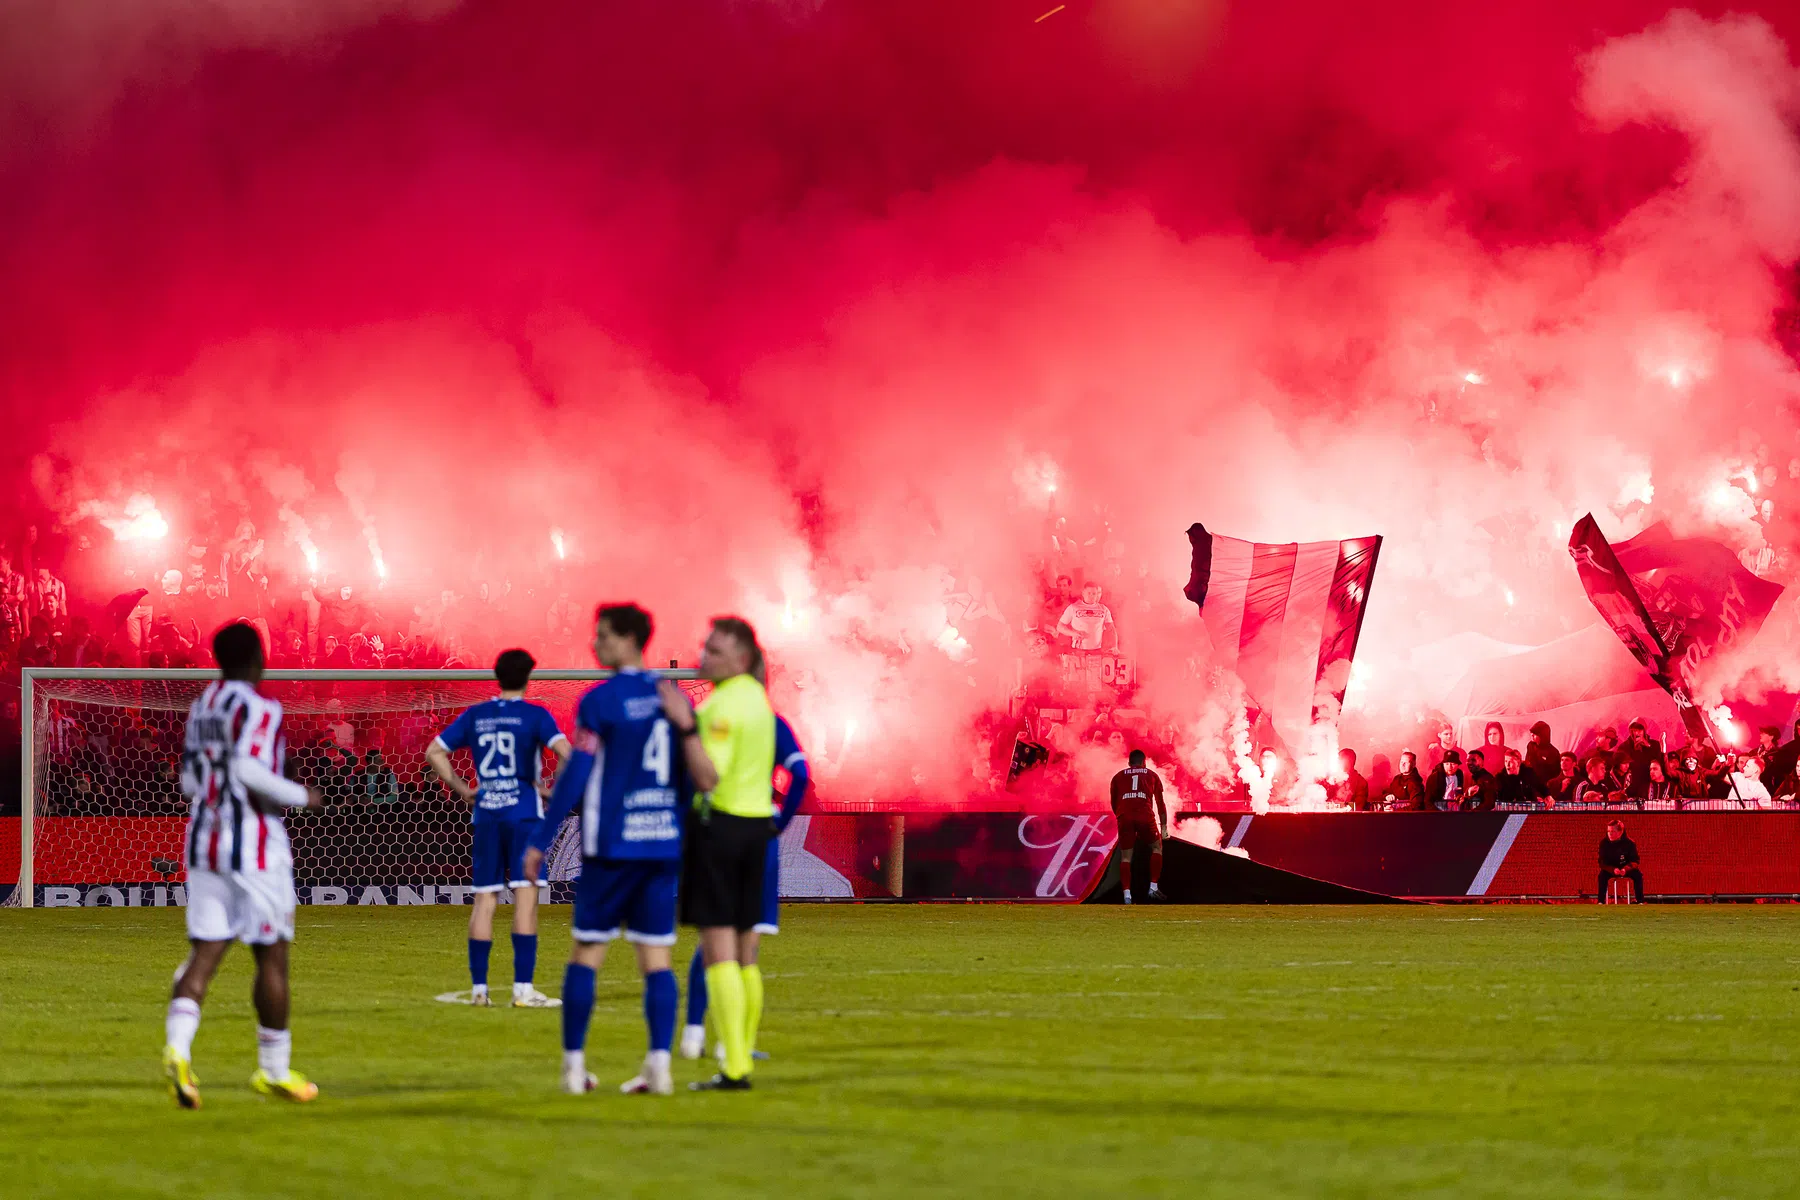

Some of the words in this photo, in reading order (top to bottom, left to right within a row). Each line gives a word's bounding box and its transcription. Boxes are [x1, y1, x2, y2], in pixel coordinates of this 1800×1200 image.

[478, 731, 516, 778] 29
[642, 718, 670, 786] 4
[1131, 774, 1139, 791] 1
